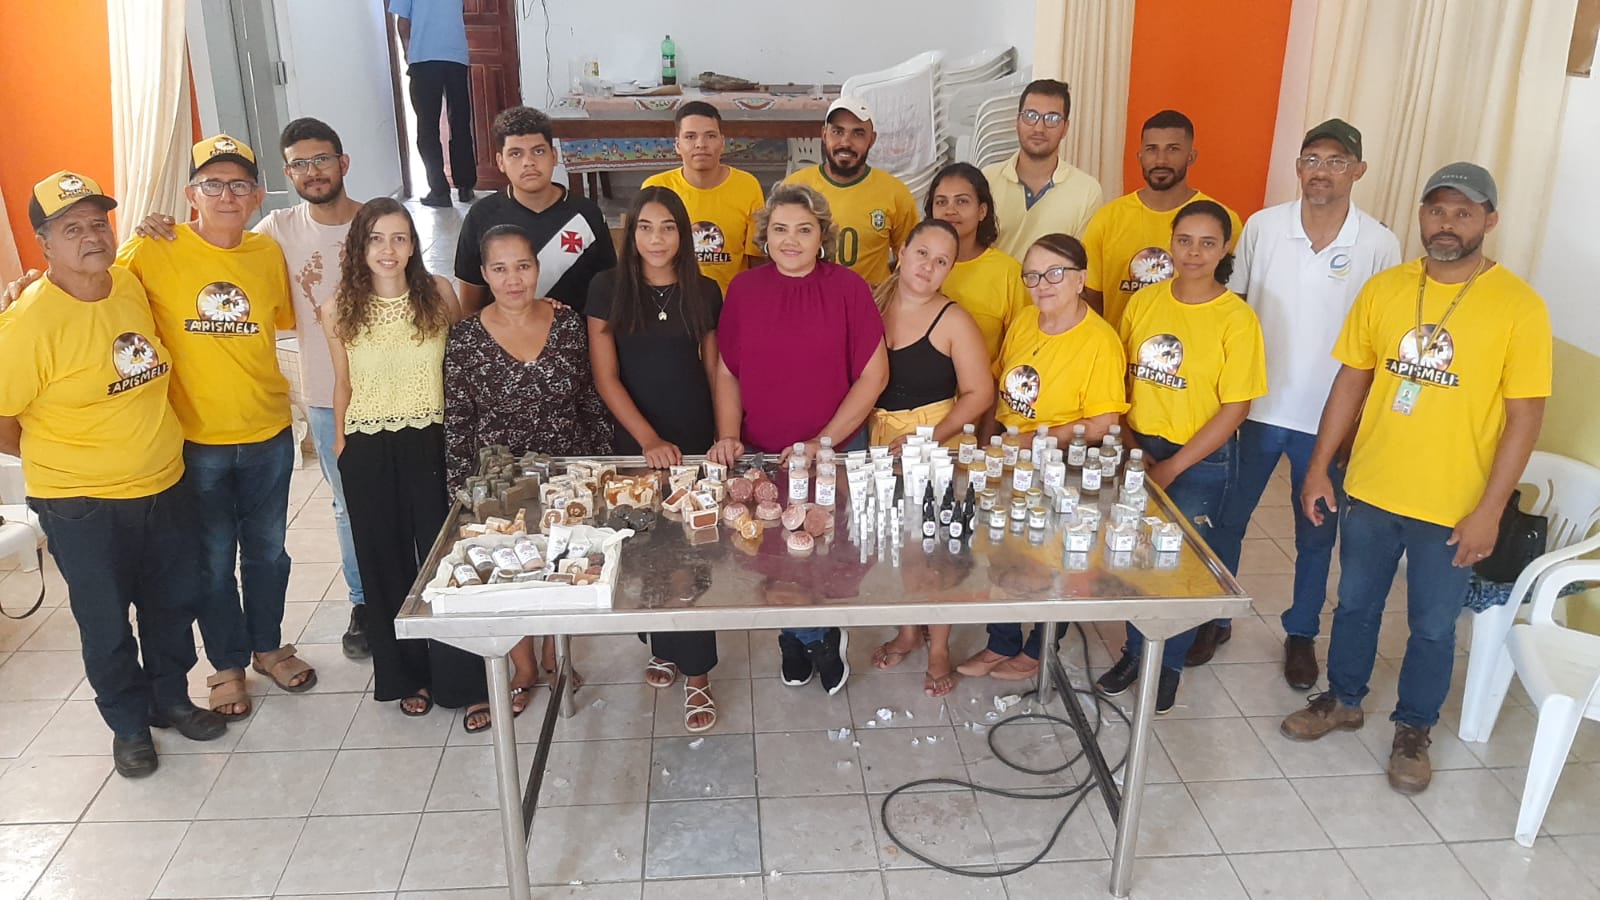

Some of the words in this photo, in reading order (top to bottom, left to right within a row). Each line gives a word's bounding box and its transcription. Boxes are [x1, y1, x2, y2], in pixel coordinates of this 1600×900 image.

[695, 253, 728, 262] SMELI
[832, 227, 858, 266] 0
[111, 364, 167, 394] APISMELI
[1391, 361, 1455, 386] APISMELI
